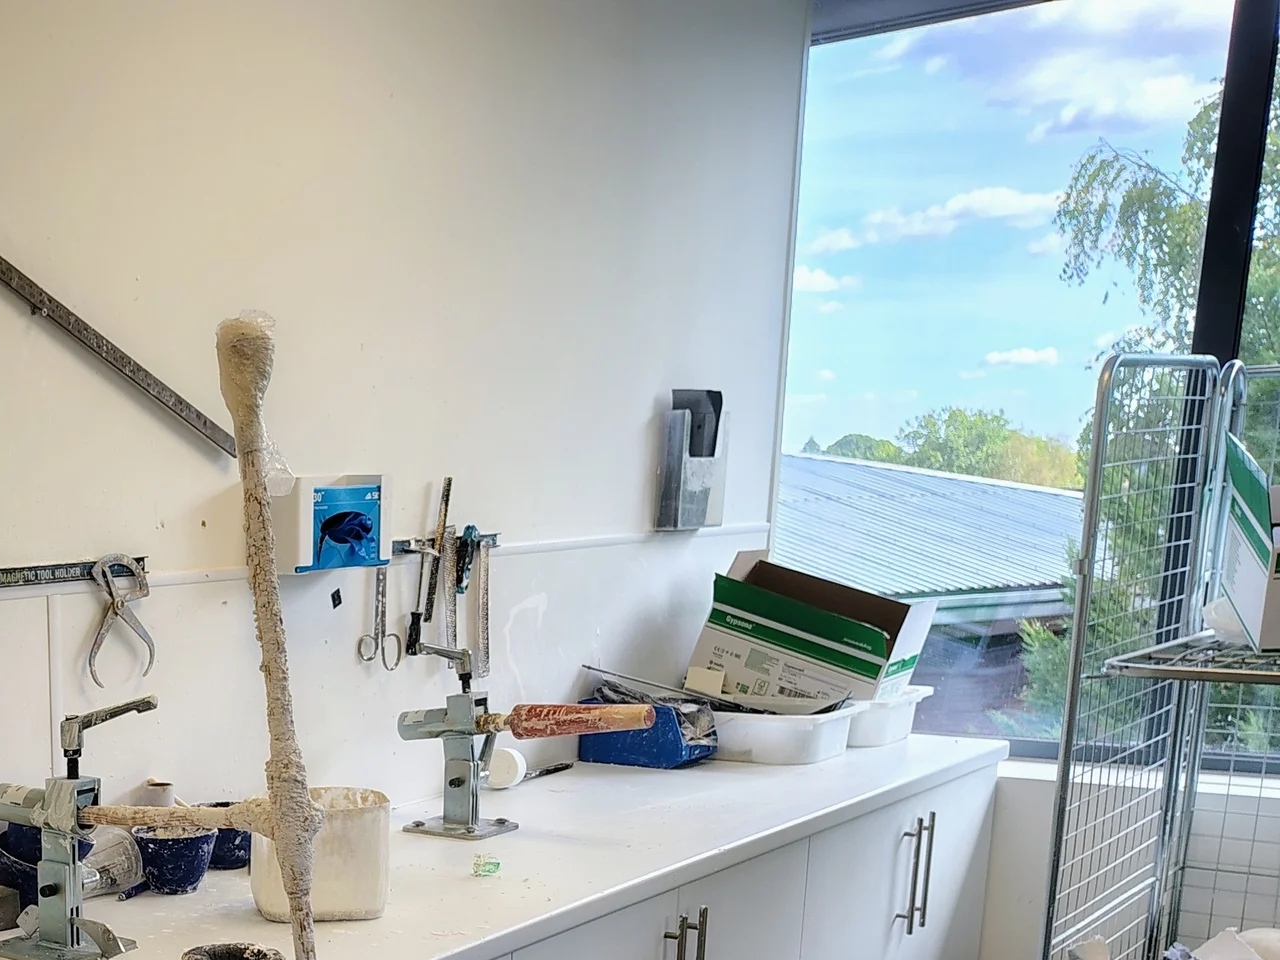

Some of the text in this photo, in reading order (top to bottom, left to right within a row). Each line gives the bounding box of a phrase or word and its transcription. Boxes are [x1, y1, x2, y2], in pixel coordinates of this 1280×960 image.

[0, 566, 80, 584] MAGNETIC TOOL HOLDER
